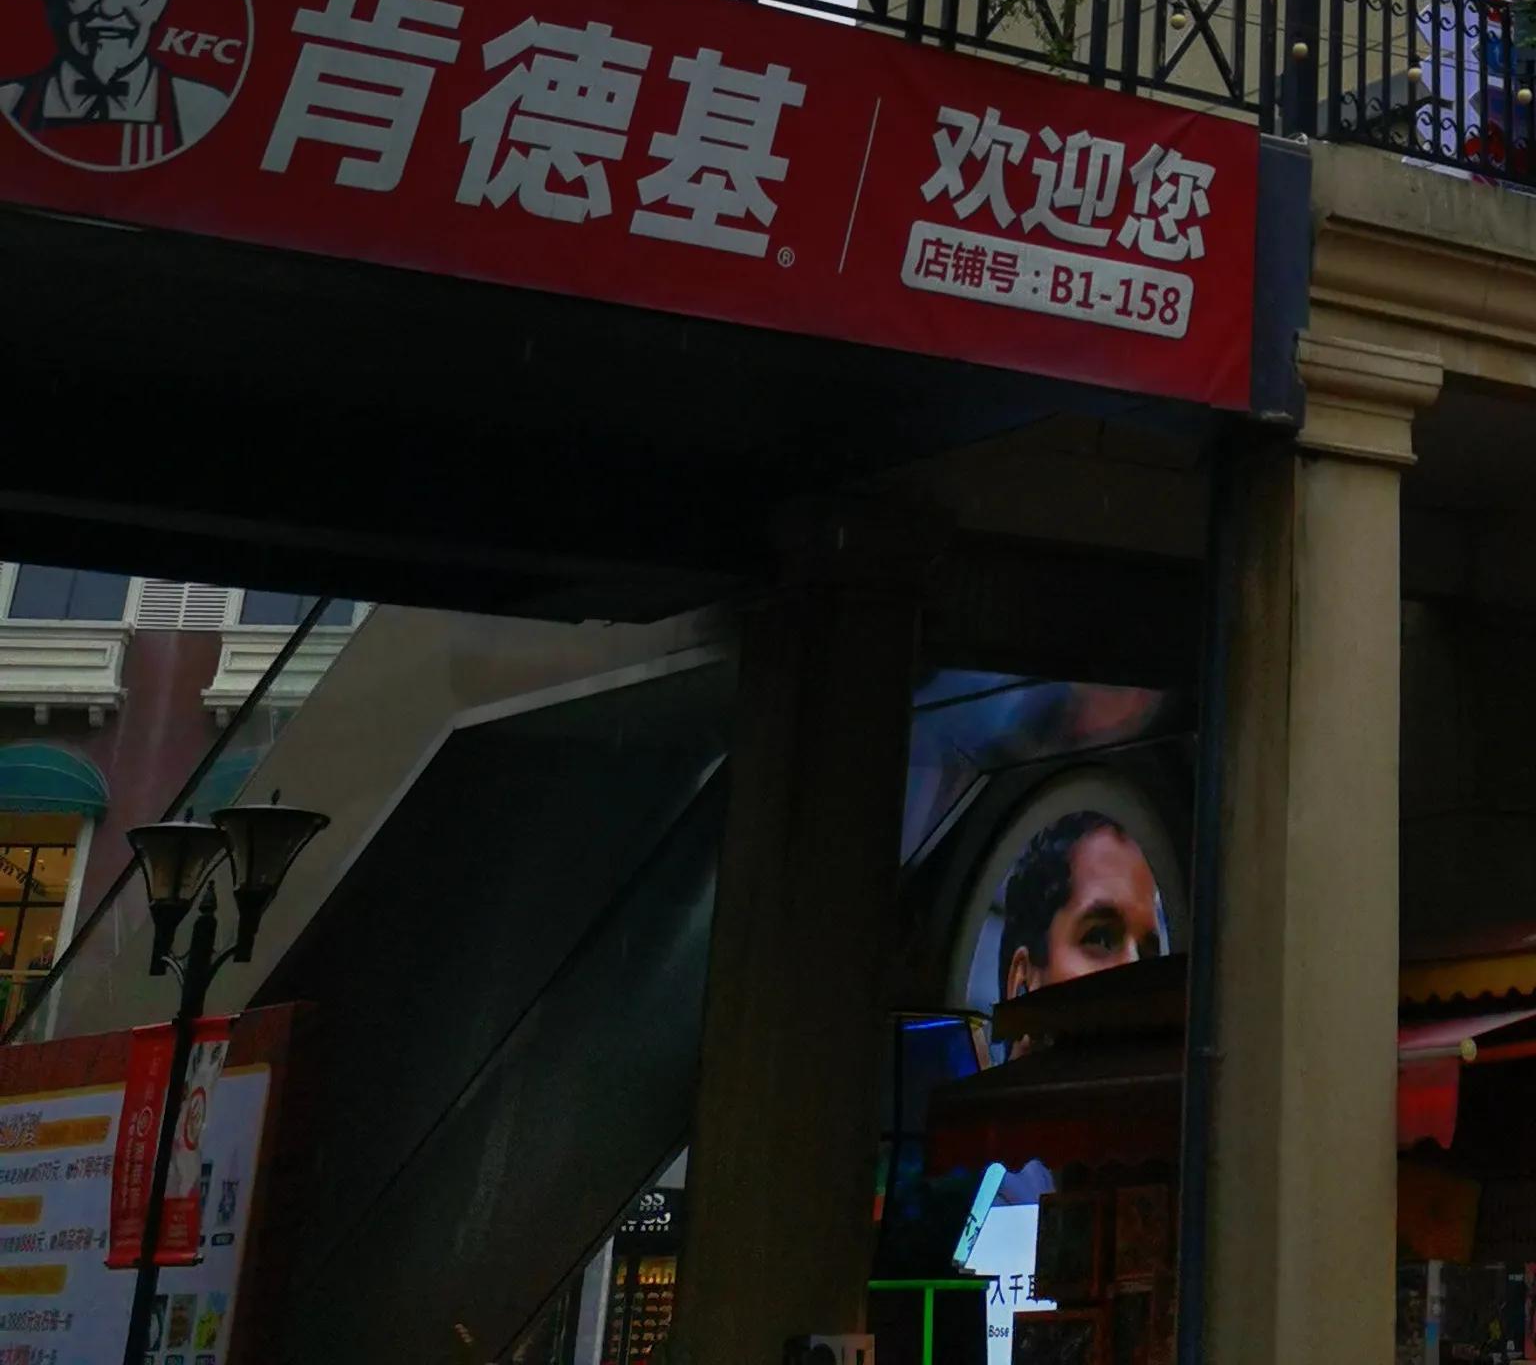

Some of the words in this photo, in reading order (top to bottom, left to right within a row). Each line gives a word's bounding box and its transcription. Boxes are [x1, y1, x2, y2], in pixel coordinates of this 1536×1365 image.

[157, 26, 243, 66] KFC
[919, 105, 1217, 263] 欢迎您
